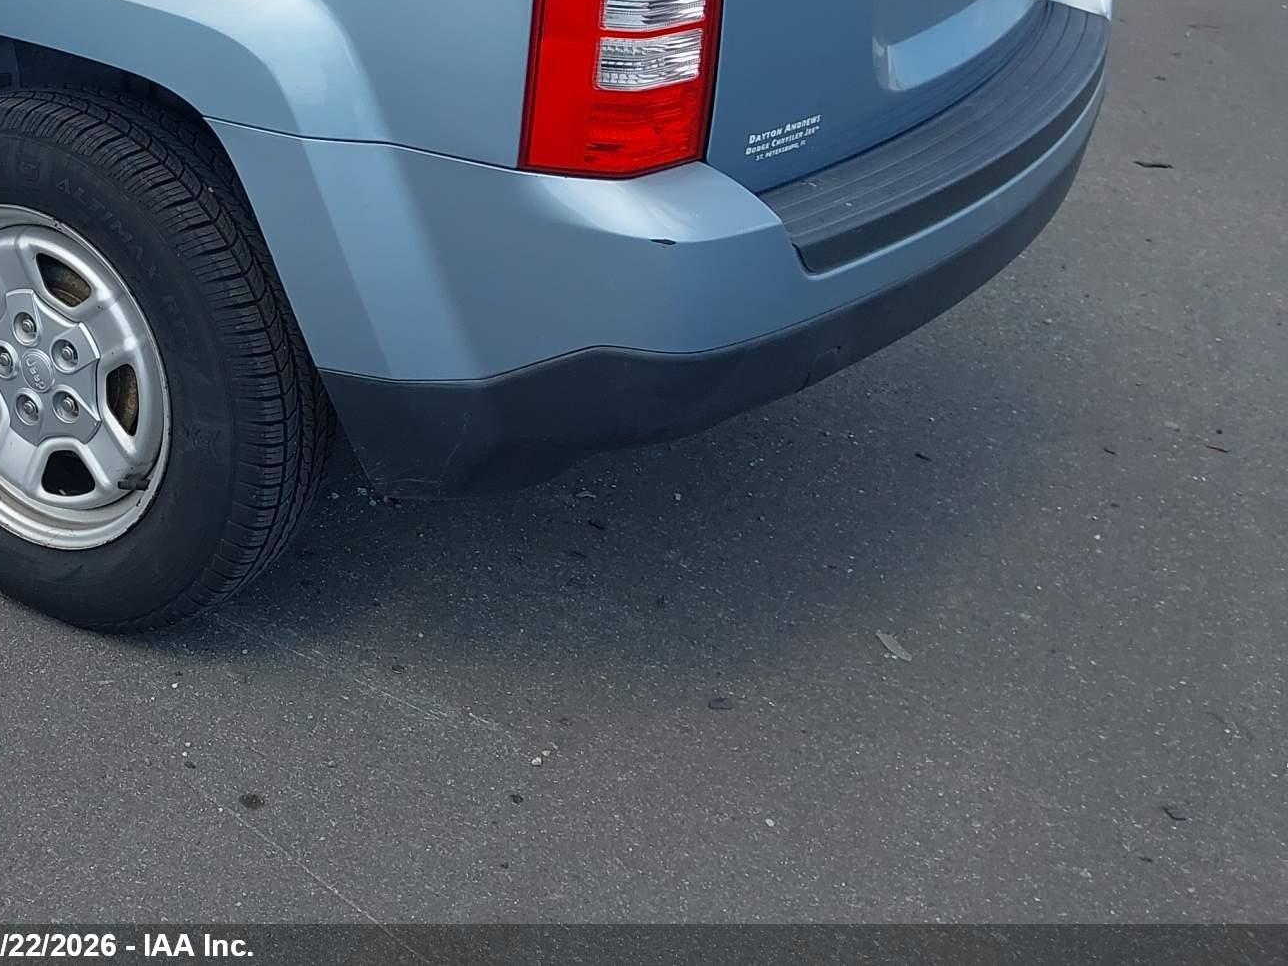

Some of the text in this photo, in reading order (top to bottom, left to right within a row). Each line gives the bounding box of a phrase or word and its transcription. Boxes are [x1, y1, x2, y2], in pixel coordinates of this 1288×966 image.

[748, 114, 822, 145] DAYTON ANDREWS
[25, 356, 47, 390] Jeep
